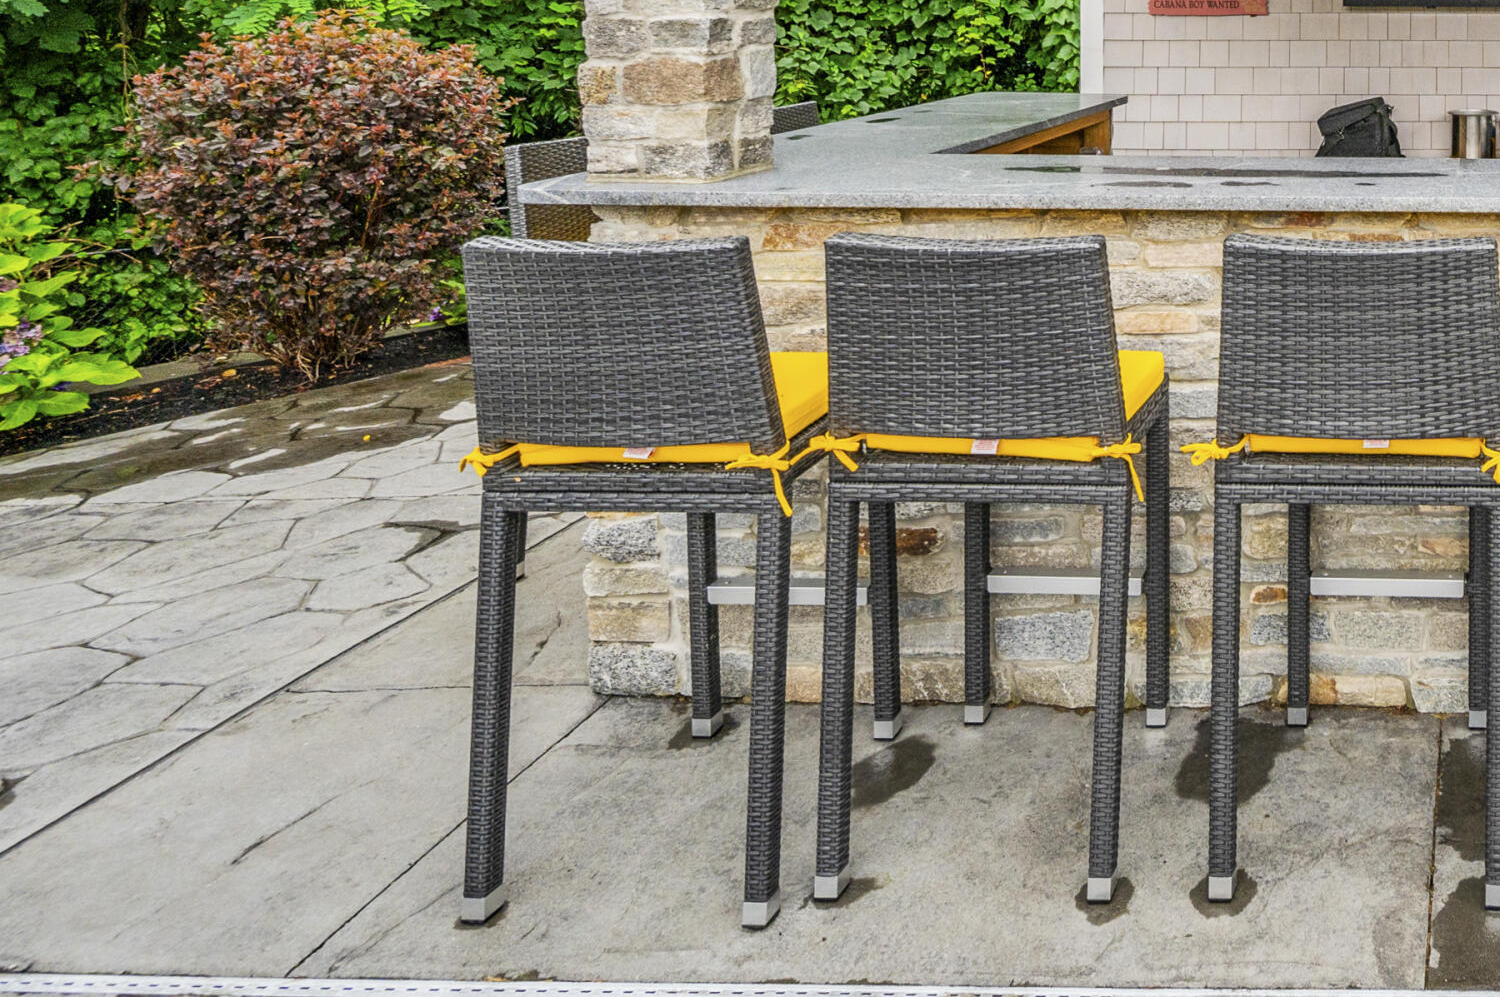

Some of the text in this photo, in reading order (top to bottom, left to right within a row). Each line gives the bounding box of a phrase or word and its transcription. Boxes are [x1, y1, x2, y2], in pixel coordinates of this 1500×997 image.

[1153, 0, 1240, 9] CABANA BOY WANTED
